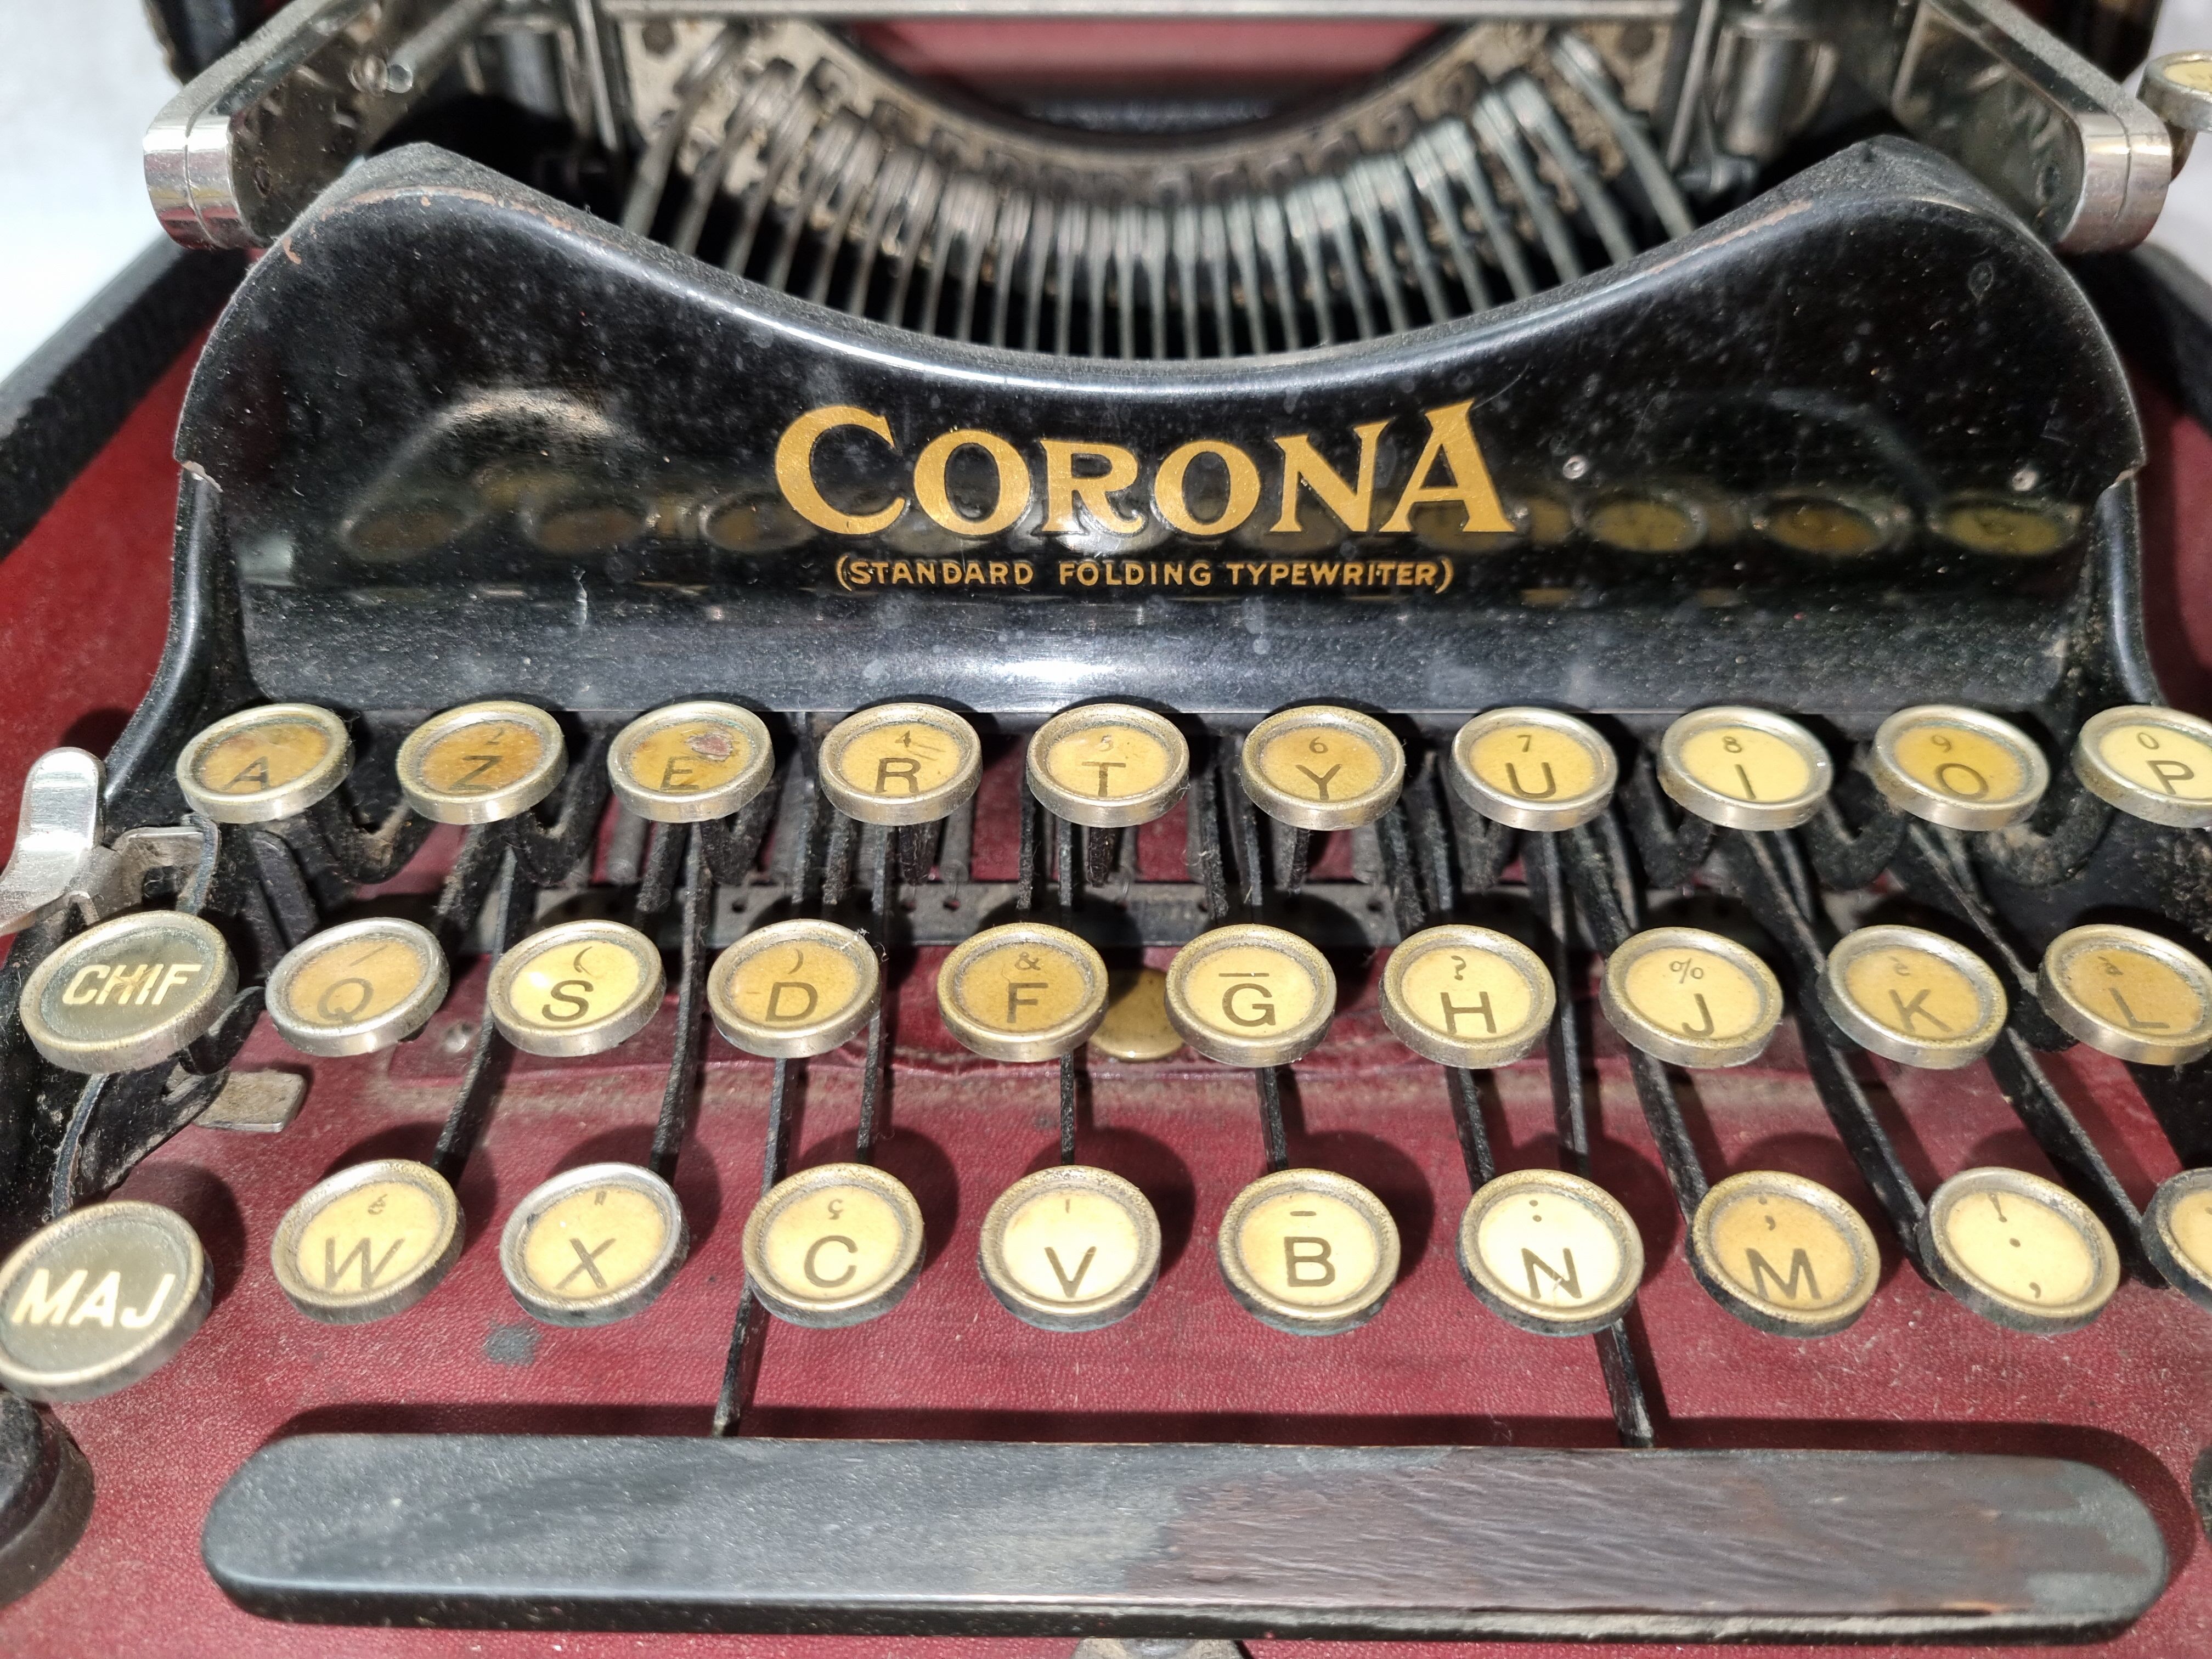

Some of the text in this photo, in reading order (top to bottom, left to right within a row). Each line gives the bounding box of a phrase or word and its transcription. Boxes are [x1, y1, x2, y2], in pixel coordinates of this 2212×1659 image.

[775, 398, 1517, 535] CORONA
[836, 555, 1454, 594] (STANDARD FOLDING TYPEWRITER)
[894, 730, 911, 748] 4
[1097, 734, 1114, 752] 5
[1309, 736, 1329, 754] 6
[1516, 734, 1532, 753] 7
[1722, 736, 1742, 754] 8
[1930, 734, 1952, 753] 9
[222, 756, 270, 792] A
[448, 755, 503, 791] Z
[659, 756, 701, 791] E
[877, 757, 919, 793] R
[1081, 761, 1126, 797] T
[1295, 763, 1342, 800] Y
[1505, 762, 1556, 799] U
[1935, 763, 1989, 800] O
[2146, 760, 2194, 795] P
[1014, 952, 1041, 971] &
[1451, 955, 1466, 981] ?
[1669, 957, 1705, 984] %
[61, 963, 203, 1006] CHIF
[317, 977, 374, 1025] Q
[542, 979, 594, 1022] S
[765, 981, 818, 1022] D
[1006, 982, 1049, 1024] F
[1221, 983, 1276, 1028] G
[1440, 991, 1497, 1034] H
[1681, 993, 1715, 1037] J
[1888, 988, 1952, 1032] K
[2108, 988, 2171, 1029] L
[324, 1237, 405, 1289] W
[555, 1238, 616, 1290] X
[803, 1235, 859, 1288] C
[1044, 1245, 1097, 1299] V
[1284, 1235, 1336, 1288] B
[1521, 1247, 1582, 1300] N
[1745, 1248, 1823, 1300] M
[11, 1267, 176, 1329] MAJ
